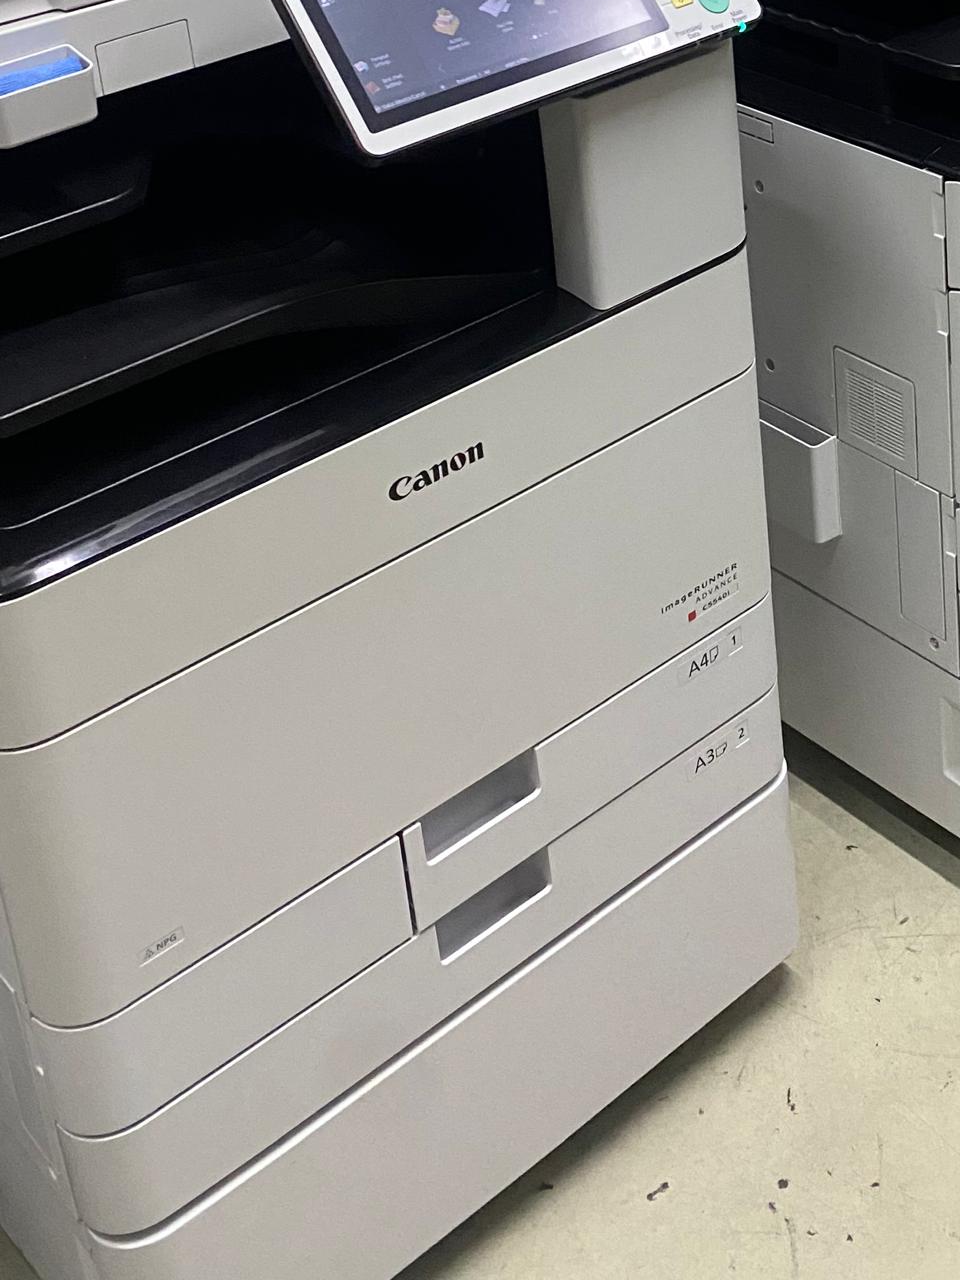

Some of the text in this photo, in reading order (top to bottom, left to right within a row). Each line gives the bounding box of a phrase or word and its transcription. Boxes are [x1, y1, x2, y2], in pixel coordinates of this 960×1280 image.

[388, 441, 484, 501] Canon
[661, 562, 738, 614] imageRUNNER
[695, 572, 738, 604] ADVANCE
[688, 652, 709, 678] A4
[694, 727, 745, 774] A3 2
